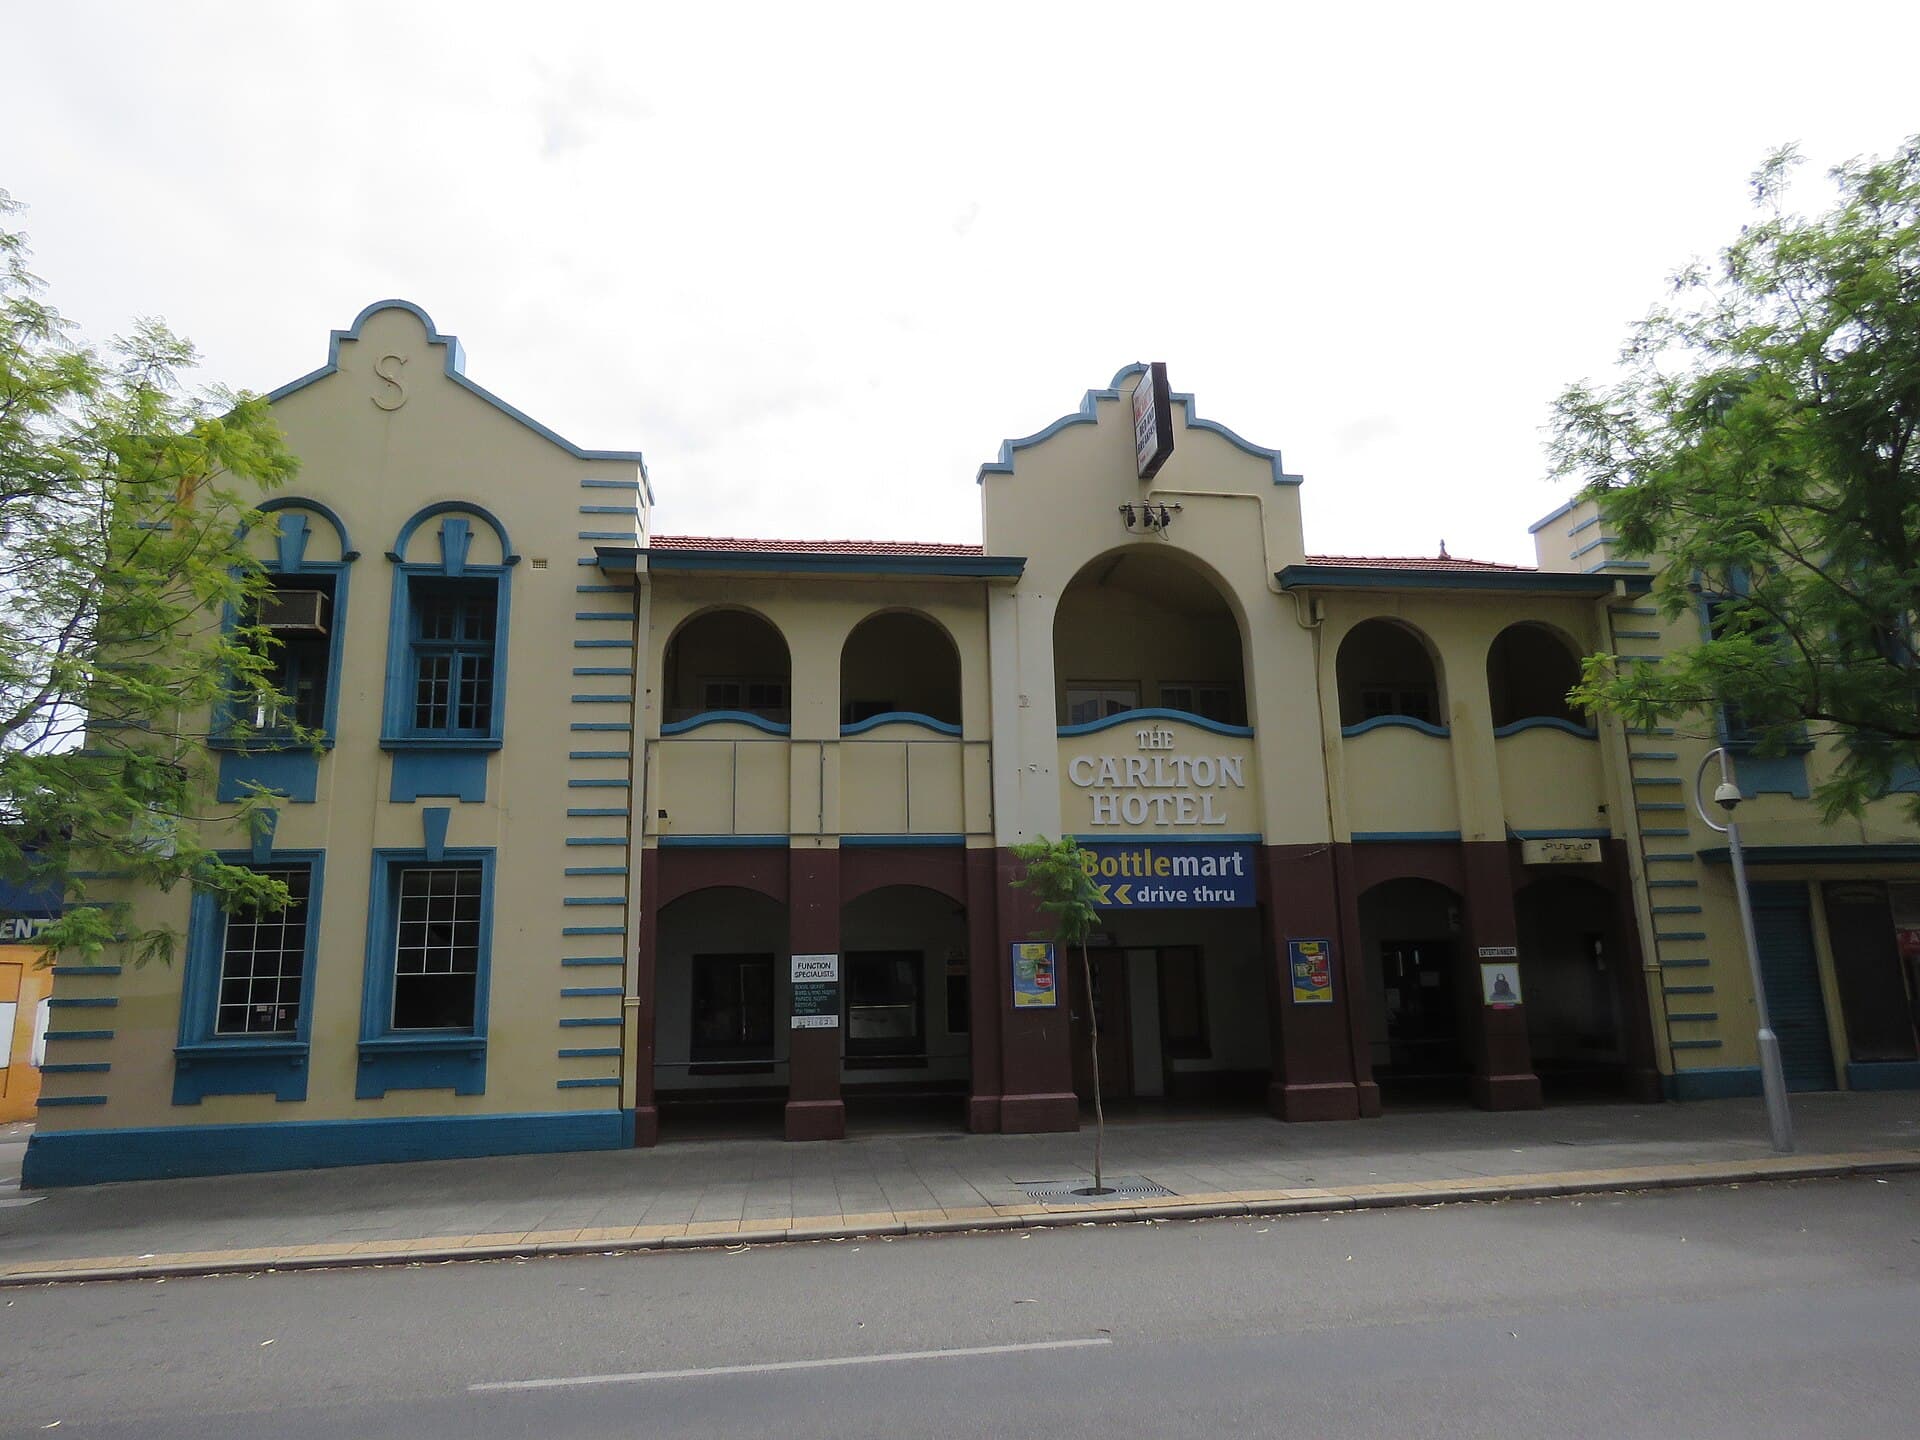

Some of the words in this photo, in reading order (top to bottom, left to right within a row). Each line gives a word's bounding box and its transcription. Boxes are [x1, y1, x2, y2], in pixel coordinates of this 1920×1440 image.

[371, 353, 408, 411] S
[1136, 729, 1175, 750] THE
[1068, 755, 1245, 787] CARLTON
[1089, 793, 1228, 825] HOTEL
[1079, 848, 1244, 877] Bottlemart
[1137, 885, 1188, 902] drive
[1193, 885, 1236, 902] thru
[795, 970, 835, 978] SPECIALISTS
[797, 962, 831, 970] FUNCTION
